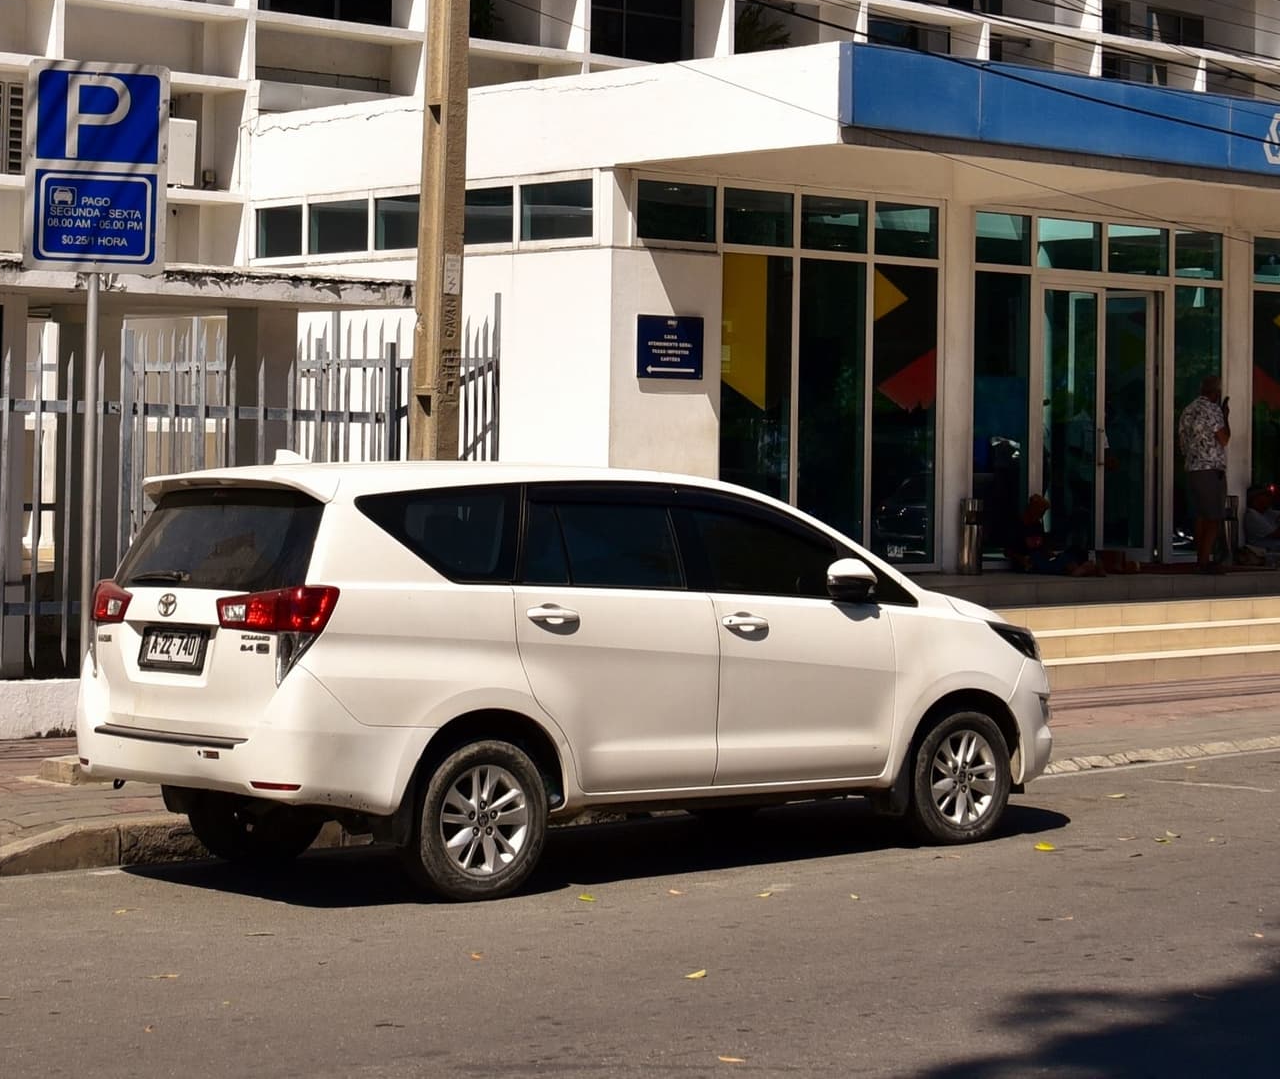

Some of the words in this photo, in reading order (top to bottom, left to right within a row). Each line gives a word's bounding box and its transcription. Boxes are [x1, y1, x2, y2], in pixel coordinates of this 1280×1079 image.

[65, 73, 131, 158] P
[81, 196, 111, 207] PAGO
[49, 206, 101, 217] SEGUNDA
[108, 209, 141, 220] SEXTA
[74, 219, 91, 229] AM
[127, 221, 143, 231] PM
[97, 236, 128, 247] HORA
